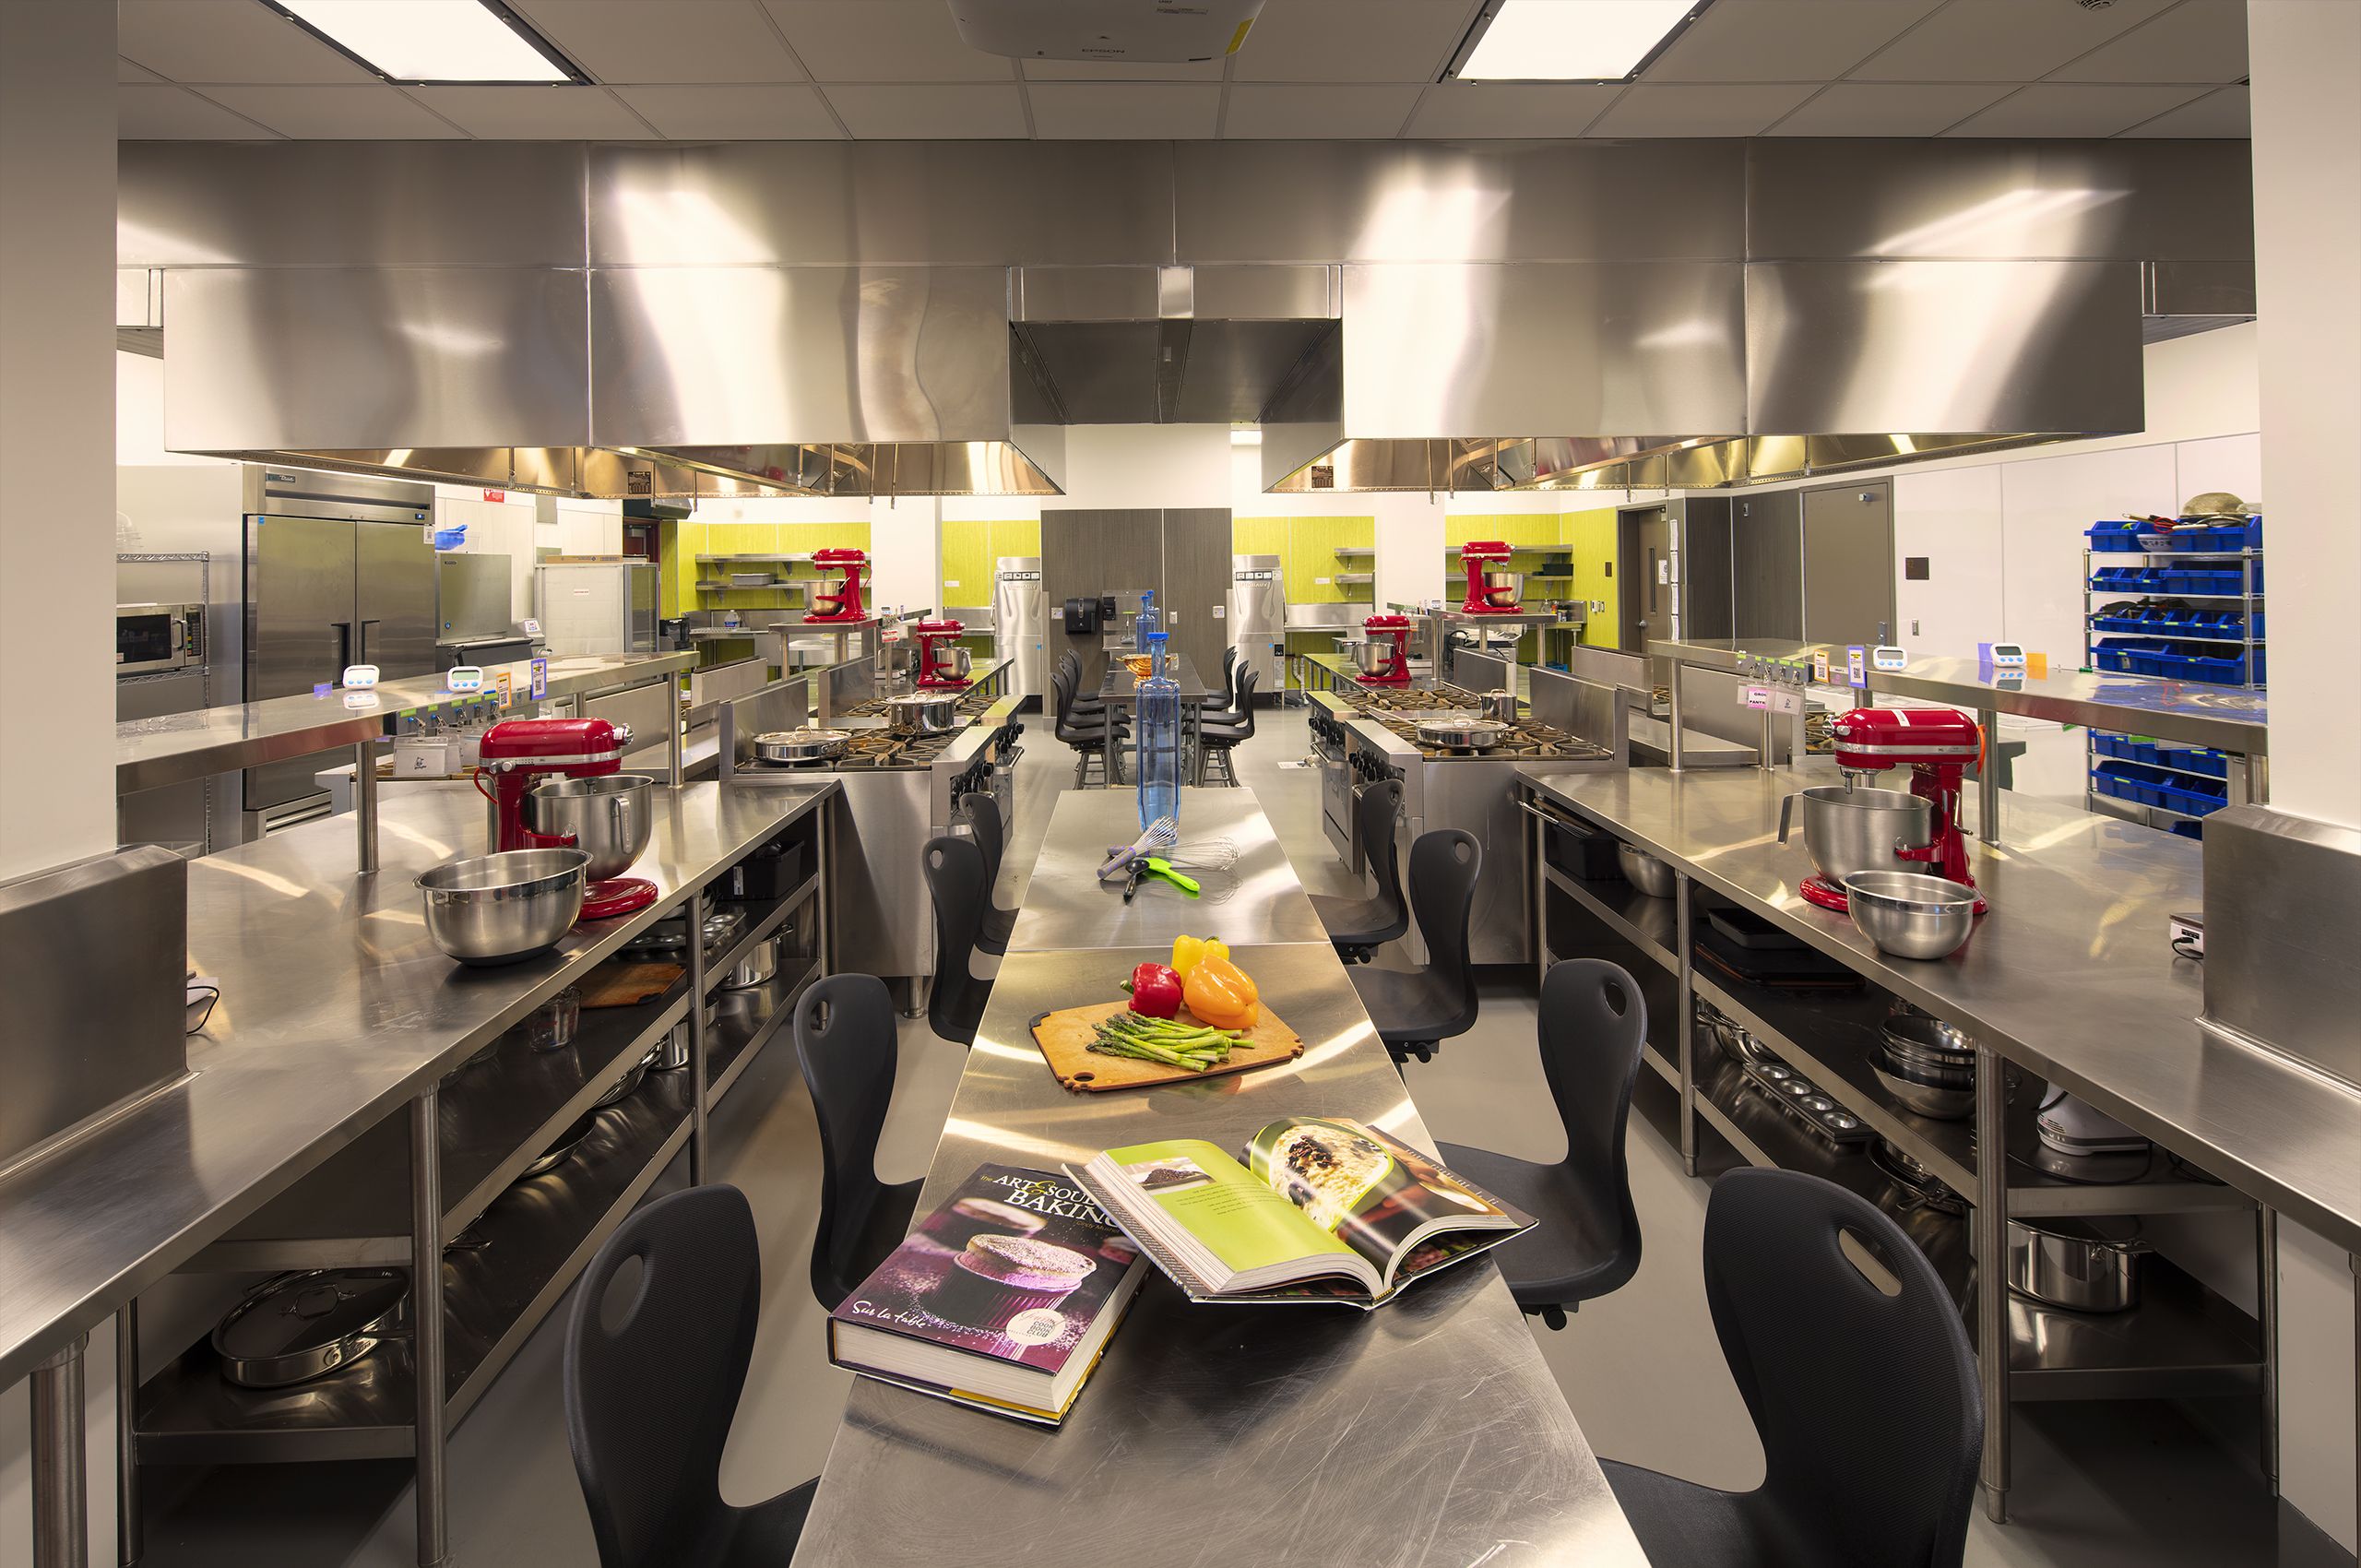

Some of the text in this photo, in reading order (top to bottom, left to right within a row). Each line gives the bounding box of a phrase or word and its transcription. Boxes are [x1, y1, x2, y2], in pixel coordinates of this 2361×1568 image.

[992, 1175, 1034, 1190] ART
[1019, 1180, 1056, 1195] &
[852, 1300, 926, 1329] Sur la table
[1029, 1324, 1050, 1334] BOOK
[1033, 1321, 1053, 1329] COOK
[1026, 1329, 1049, 1337] CLUB
